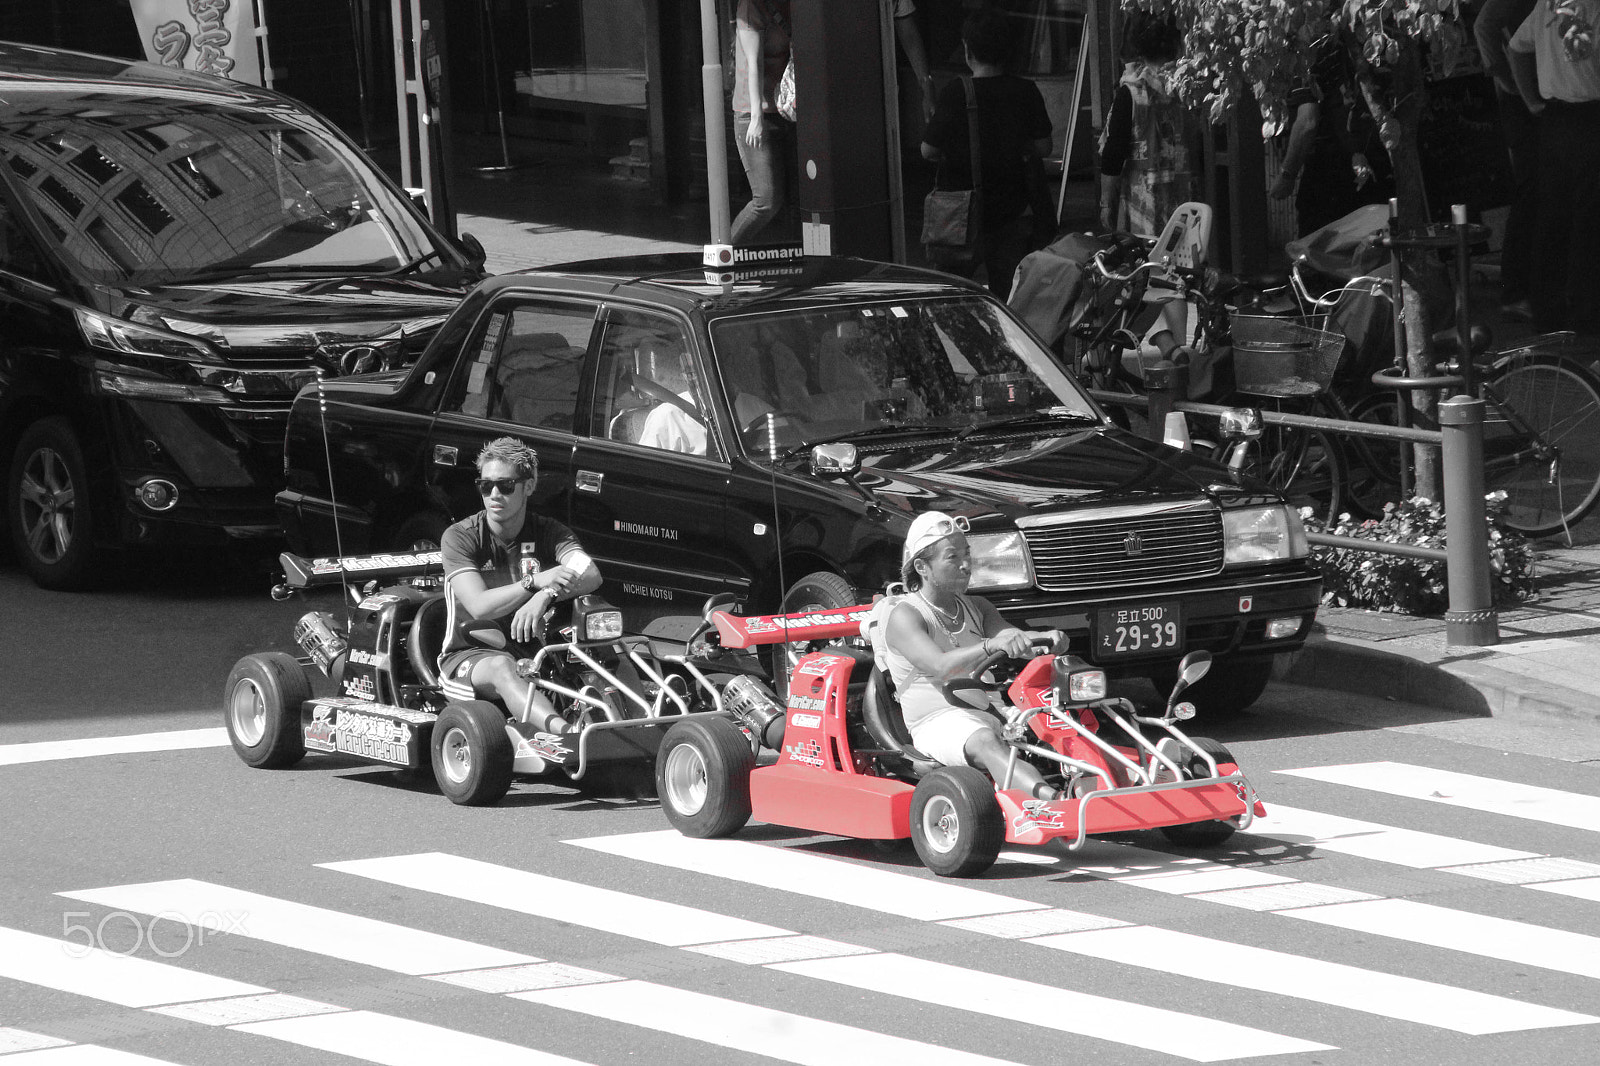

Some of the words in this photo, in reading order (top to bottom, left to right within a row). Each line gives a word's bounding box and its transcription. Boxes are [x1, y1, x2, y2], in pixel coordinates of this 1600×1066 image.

[733, 247, 803, 262] Hinomaru
[620, 521, 659, 538] HINOMARU
[660, 528, 678, 540] TAXI
[623, 583, 649, 597] NICHIEI
[650, 587, 673, 601] KOTSU
[1117, 610, 1140, 624] 足立
[1142, 607, 1163, 621] 500
[1103, 635, 1112, 647] え
[1115, 621, 1177, 652] 29-39
[336, 729, 409, 765] MariCar.com
